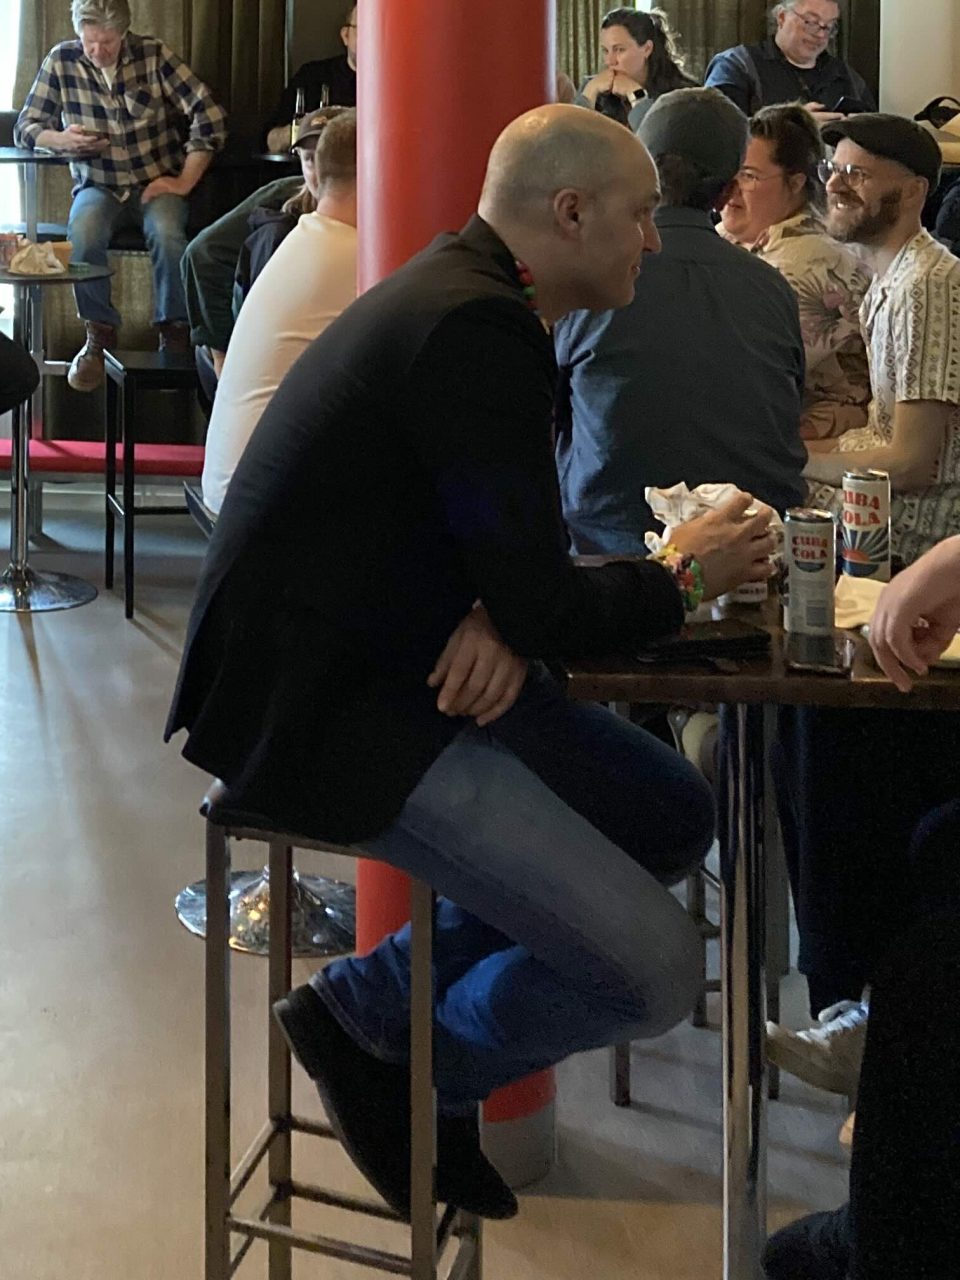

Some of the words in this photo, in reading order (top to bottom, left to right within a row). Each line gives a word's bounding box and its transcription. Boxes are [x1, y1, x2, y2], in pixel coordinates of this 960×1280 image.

[843, 490, 880, 510] UBA
[844, 510, 881, 526] OLA
[791, 536, 828, 548] CUBA
[791, 547, 828, 559] COLA
